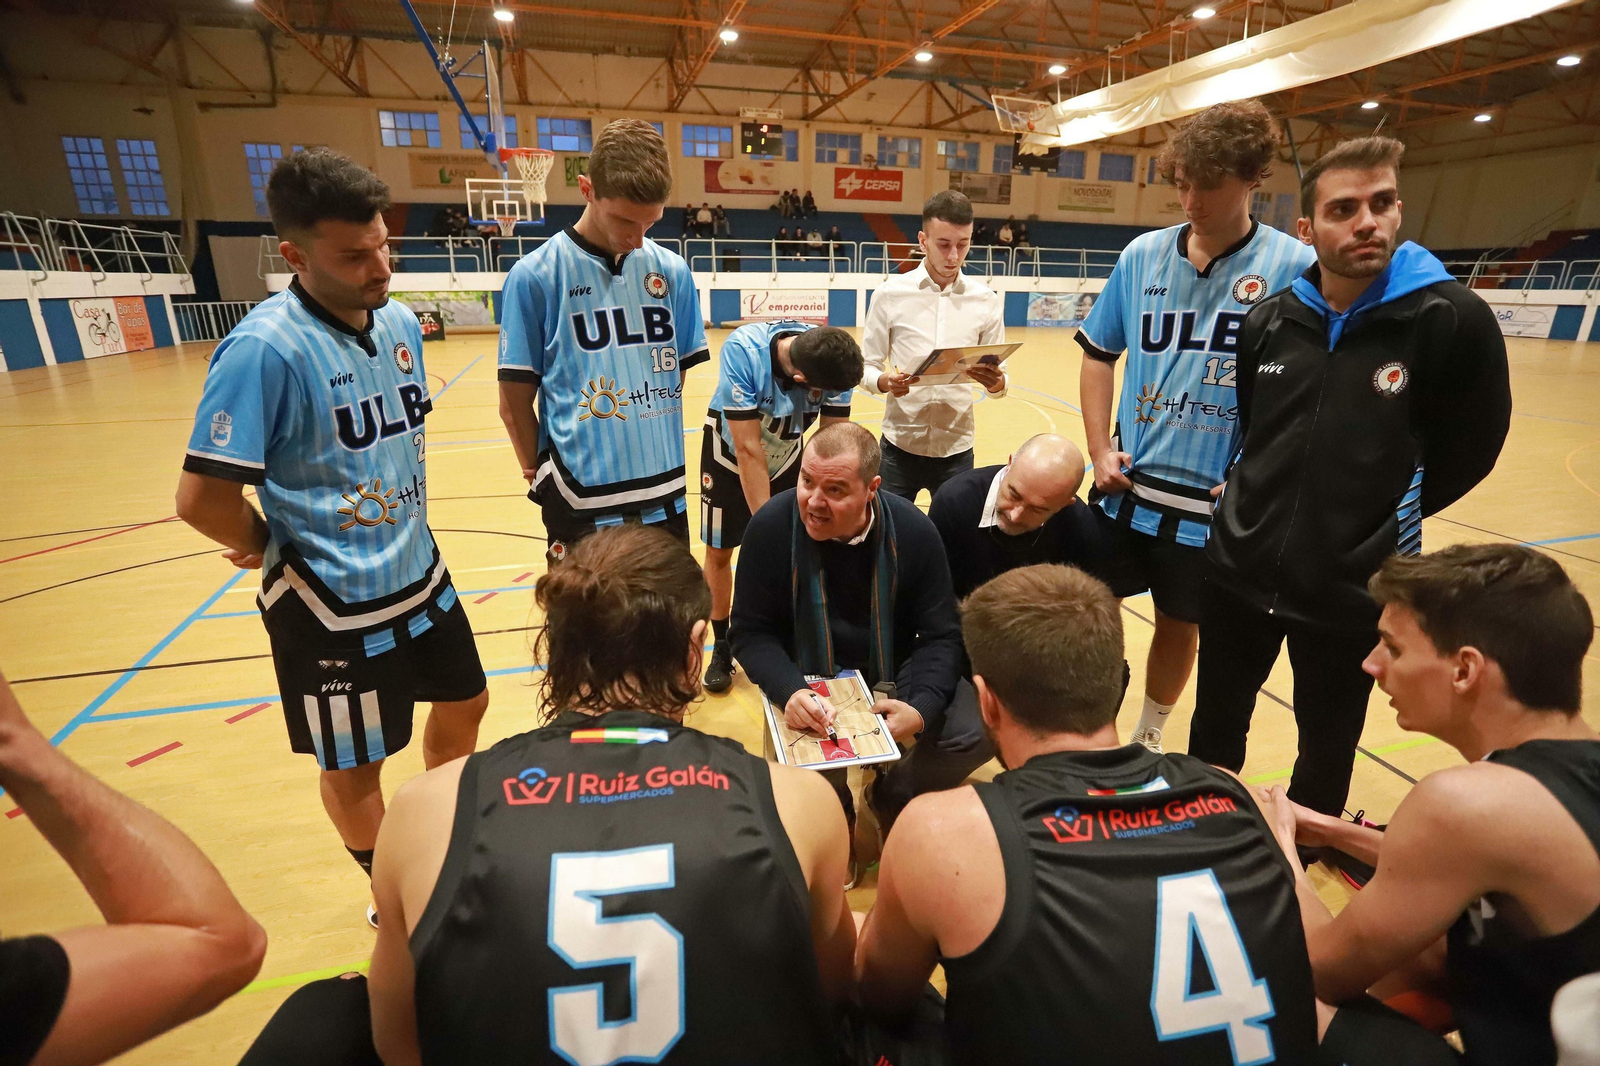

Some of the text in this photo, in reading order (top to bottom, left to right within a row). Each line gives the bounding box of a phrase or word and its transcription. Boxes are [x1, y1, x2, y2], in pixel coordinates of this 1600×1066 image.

[864, 179, 901, 191] CEPSA
[73, 300, 101, 318] Casa
[117, 302, 142, 315] Bar de
[768, 302, 826, 313] empresarial
[120, 316, 146, 327] Tapas
[570, 304, 676, 353] ULB
[651, 347, 677, 373] 16
[1202, 357, 1236, 388] 12
[332, 381, 425, 453] ULB
[1165, 420, 1191, 430] HOTELS
[1200, 424, 1232, 435] RESORTS
[579, 764, 730, 796] Ruiz Galán
[579, 787, 675, 804] SUPERMERCADOS
[1109, 793, 1238, 831] Ruiz Galán
[1114, 820, 1195, 839] SUPERMERCADOS
[547, 843, 686, 1066] 5
[1150, 868, 1276, 1066] 4
